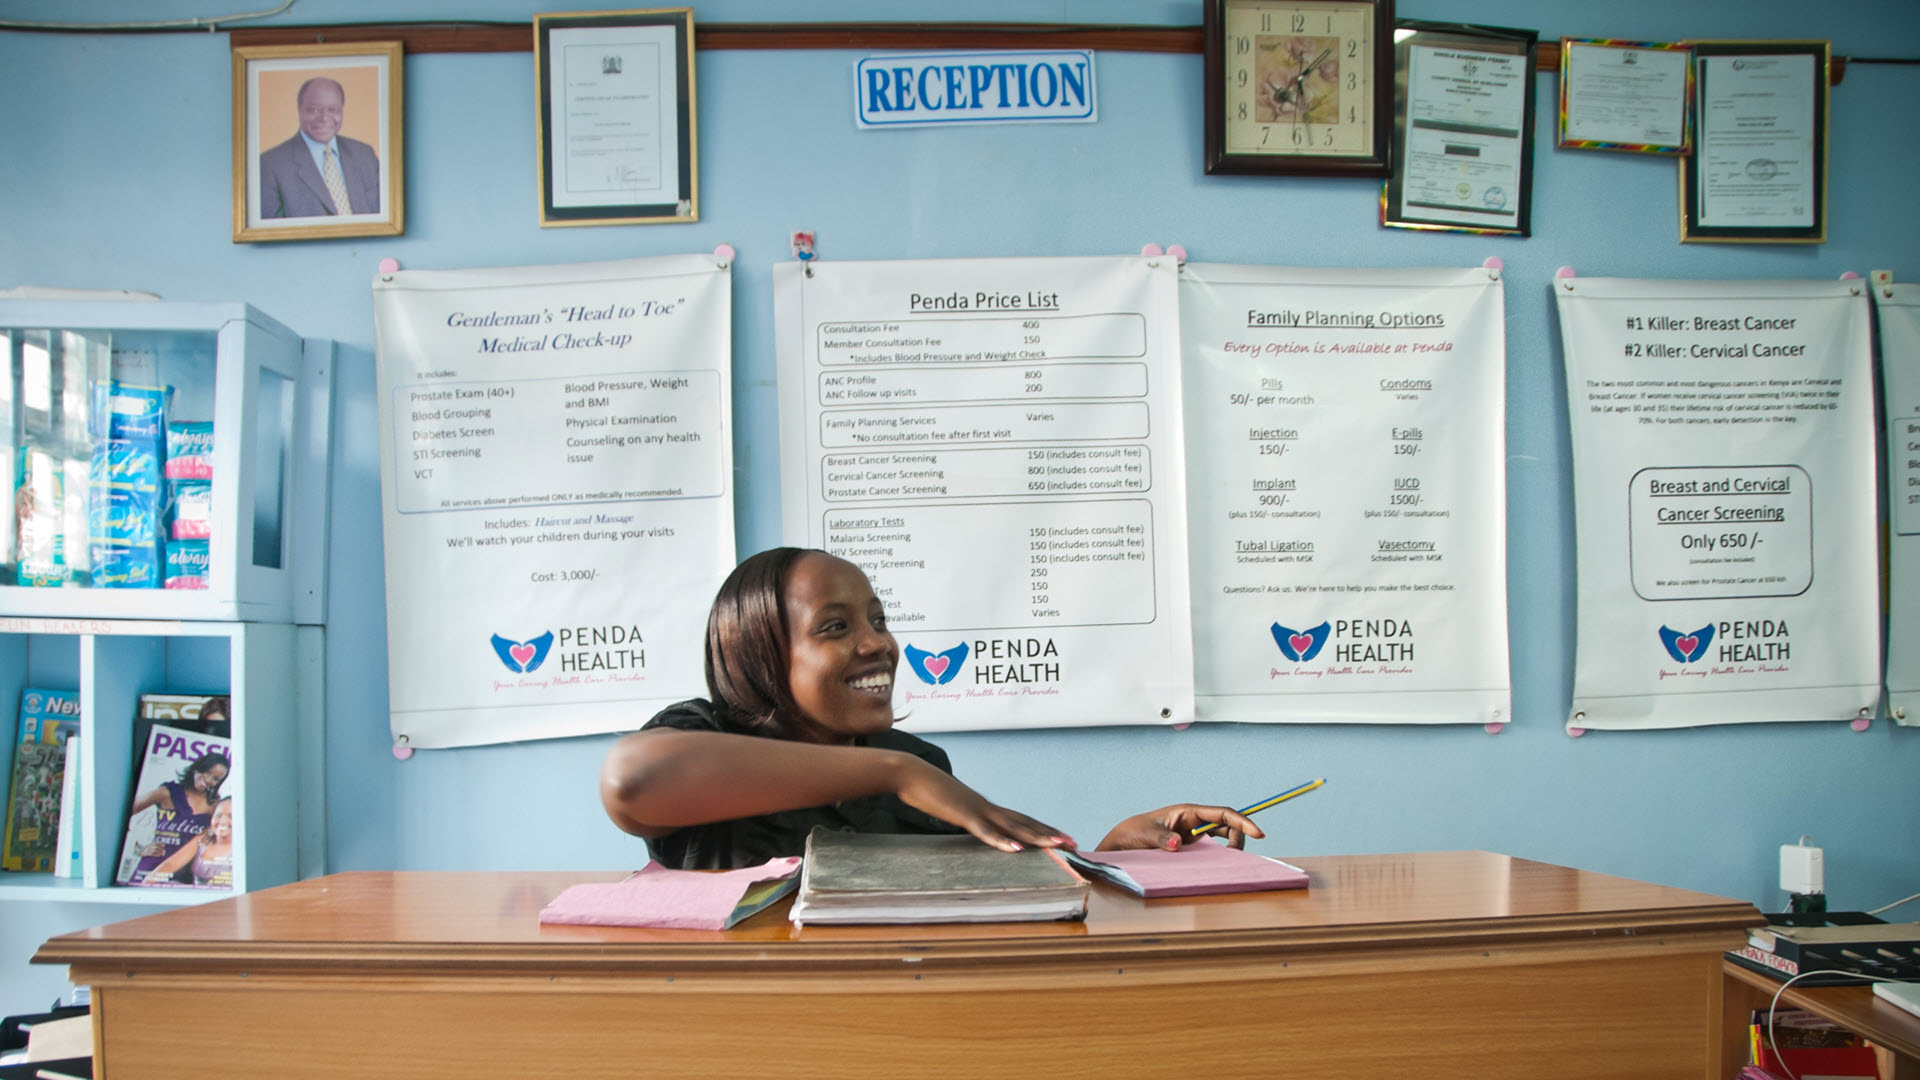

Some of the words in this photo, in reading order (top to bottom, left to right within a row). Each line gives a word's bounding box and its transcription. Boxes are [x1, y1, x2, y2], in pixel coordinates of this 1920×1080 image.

[1262, 14, 1270, 32] 11
[1292, 14, 1304, 32] 12
[1327, 16, 1330, 34] 1
[1236, 36, 1250, 54] 10
[1347, 40, 1356, 58] 2
[1238, 69, 1247, 88] 9
[1347, 72, 1356, 90] 3
[866, 62, 1088, 113] RECEPTION
[1238, 102, 1247, 120] 8
[1347, 105, 1356, 123] 4
[1262, 126, 1270, 144] 7
[1292, 128, 1302, 145] 6
[1324, 128, 1333, 146] 5
[910, 293, 969, 310] Penda
[975, 292, 1021, 309] Price
[1028, 291, 1059, 308] List
[618, 306, 636, 319] to
[1248, 310, 1300, 327] Family
[1305, 311, 1374, 328] Planning
[1380, 311, 1445, 327] Options
[823, 323, 881, 334] Consultation
[884, 323, 899, 332] Fee
[1022, 321, 1039, 329] 400
[1626, 317, 1644, 330] #1
[1648, 316, 1690, 331] Killer:
[1694, 316, 1740, 330] Breast
[1744, 316, 1796, 330] Cancer
[478, 336, 546, 354] Medical
[550, 332, 633, 350] Check-up
[824, 338, 862, 349] Member
[865, 337, 922, 348] Consultation
[926, 337, 941, 346] Fee
[1024, 335, 1040, 344] 150
[1224, 342, 1261, 358] Every
[1265, 341, 1310, 357] Option
[1314, 342, 1325, 354] is
[1331, 341, 1391, 354] Available
[1394, 343, 1407, 353] at
[1412, 341, 1453, 353] Penda
[1625, 344, 1642, 357] #2
[1646, 343, 1687, 358] Killer:
[1690, 343, 1748, 357] Cervical
[1752, 343, 1806, 357] Cancer
[565, 382, 596, 393] Blood
[650, 378, 688, 390] Weight
[825, 376, 844, 386] ANC
[847, 376, 876, 385] Profile
[1024, 371, 1041, 379] 800
[1261, 378, 1283, 388] Pills
[1380, 378, 1432, 389] Condoms
[411, 390, 453, 402] Prostate
[455, 388, 484, 399] Exam
[487, 387, 515, 399] (40+)
[826, 390, 844, 399] ANC
[847, 389, 876, 398] Follow
[879, 389, 891, 399] up
[894, 387, 916, 397] visits
[1025, 384, 1042, 392] 200
[565, 398, 585, 409] and
[588, 397, 609, 407] BMI
[1230, 394, 1254, 405] 50/-
[1257, 396, 1275, 407] per
[1278, 394, 1314, 405] month
[412, 410, 441, 421] Blood
[443, 407, 491, 422] Grouping
[566, 416, 608, 429] Physical
[611, 414, 677, 426] Examination
[826, 419, 856, 430] Family
[858, 417, 898, 428] Planning
[900, 416, 936, 426] Services
[1026, 412, 1054, 422] Varies
[413, 429, 456, 441] Diabetes
[459, 427, 495, 438] Screen
[567, 436, 624, 448] Counseling
[628, 436, 641, 445] on
[645, 434, 663, 447] any
[667, 432, 700, 443] health
[1250, 428, 1298, 439] Injection
[1392, 428, 1423, 439] E-pills
[431, 447, 481, 460] Screening
[567, 452, 593, 463] issue
[1259, 444, 1290, 456] 150/-
[1393, 444, 1421, 456] 150/-
[414, 469, 433, 480] VCT
[828, 471, 862, 482] Cervical
[865, 470, 897, 481] Cancer
[899, 469, 944, 481] Screening
[1028, 466, 1044, 475] 800
[1047, 465, 1086, 476] (includes
[1089, 463, 1121, 474] consult
[1124, 463, 1142, 474] fee)
[1253, 478, 1296, 490] Implant
[1394, 478, 1420, 489] IUCD
[1651, 480, 1698, 494] Breast
[1703, 479, 1729, 492] and
[1734, 477, 1790, 492] Cervical
[1259, 494, 1290, 507] 900/-
[1390, 494, 1424, 506] 1500/-
[485, 518, 532, 529] Includes:
[535, 516, 571, 528] Haircut
[574, 515, 591, 526] and
[594, 513, 634, 526] Massage
[1657, 507, 1709, 522] Cancer
[1714, 505, 1784, 521] Screening
[829, 518, 879, 530] Laboratory
[881, 516, 904, 528] Tests
[476, 535, 507, 546] watch
[510, 534, 533, 545] your
[537, 531, 580, 543] children
[583, 530, 618, 542] during
[621, 529, 644, 541] your
[648, 527, 675, 537] visits
[830, 532, 864, 543] Malaria
[867, 531, 911, 543] Screening
[1030, 528, 1046, 537] 150
[1681, 533, 1715, 551] Only
[1720, 532, 1747, 548] 650
[1750, 531, 1763, 549] /-
[830, 546, 846, 556] HIV
[849, 546, 893, 558] Screening
[1236, 540, 1267, 550] Tubal
[1270, 540, 1314, 552] Ligation
[1378, 539, 1435, 551] Vasectomy
[169, 548, 209, 571] alway
[531, 572, 558, 582] Cost:
[1031, 568, 1048, 577] 250
[875, 586, 892, 596] Test
[1031, 581, 1048, 591] 150
[1223, 585, 1265, 594] Questions?
[1267, 585, 1280, 593] Ask
[1319, 584, 1335, 593] here
[1347, 584, 1362, 594] help
[1364, 586, 1377, 594] you
[1379, 584, 1398, 592] make
[1400, 584, 1412, 592] the
[1414, 584, 1429, 592] best
[883, 599, 901, 609] Test
[886, 612, 926, 622] available
[1032, 608, 1060, 618] Varies
[1336, 619, 1413, 637] PENDA
[1719, 620, 1789, 639] PENDA
[559, 625, 643, 648] PENDA
[974, 639, 1058, 659] PENDA
[1337, 643, 1414, 662] HEALTH
[1720, 642, 1790, 662] HEALTH
[561, 650, 646, 672] HEALTH
[975, 662, 1060, 685] HEALTH
